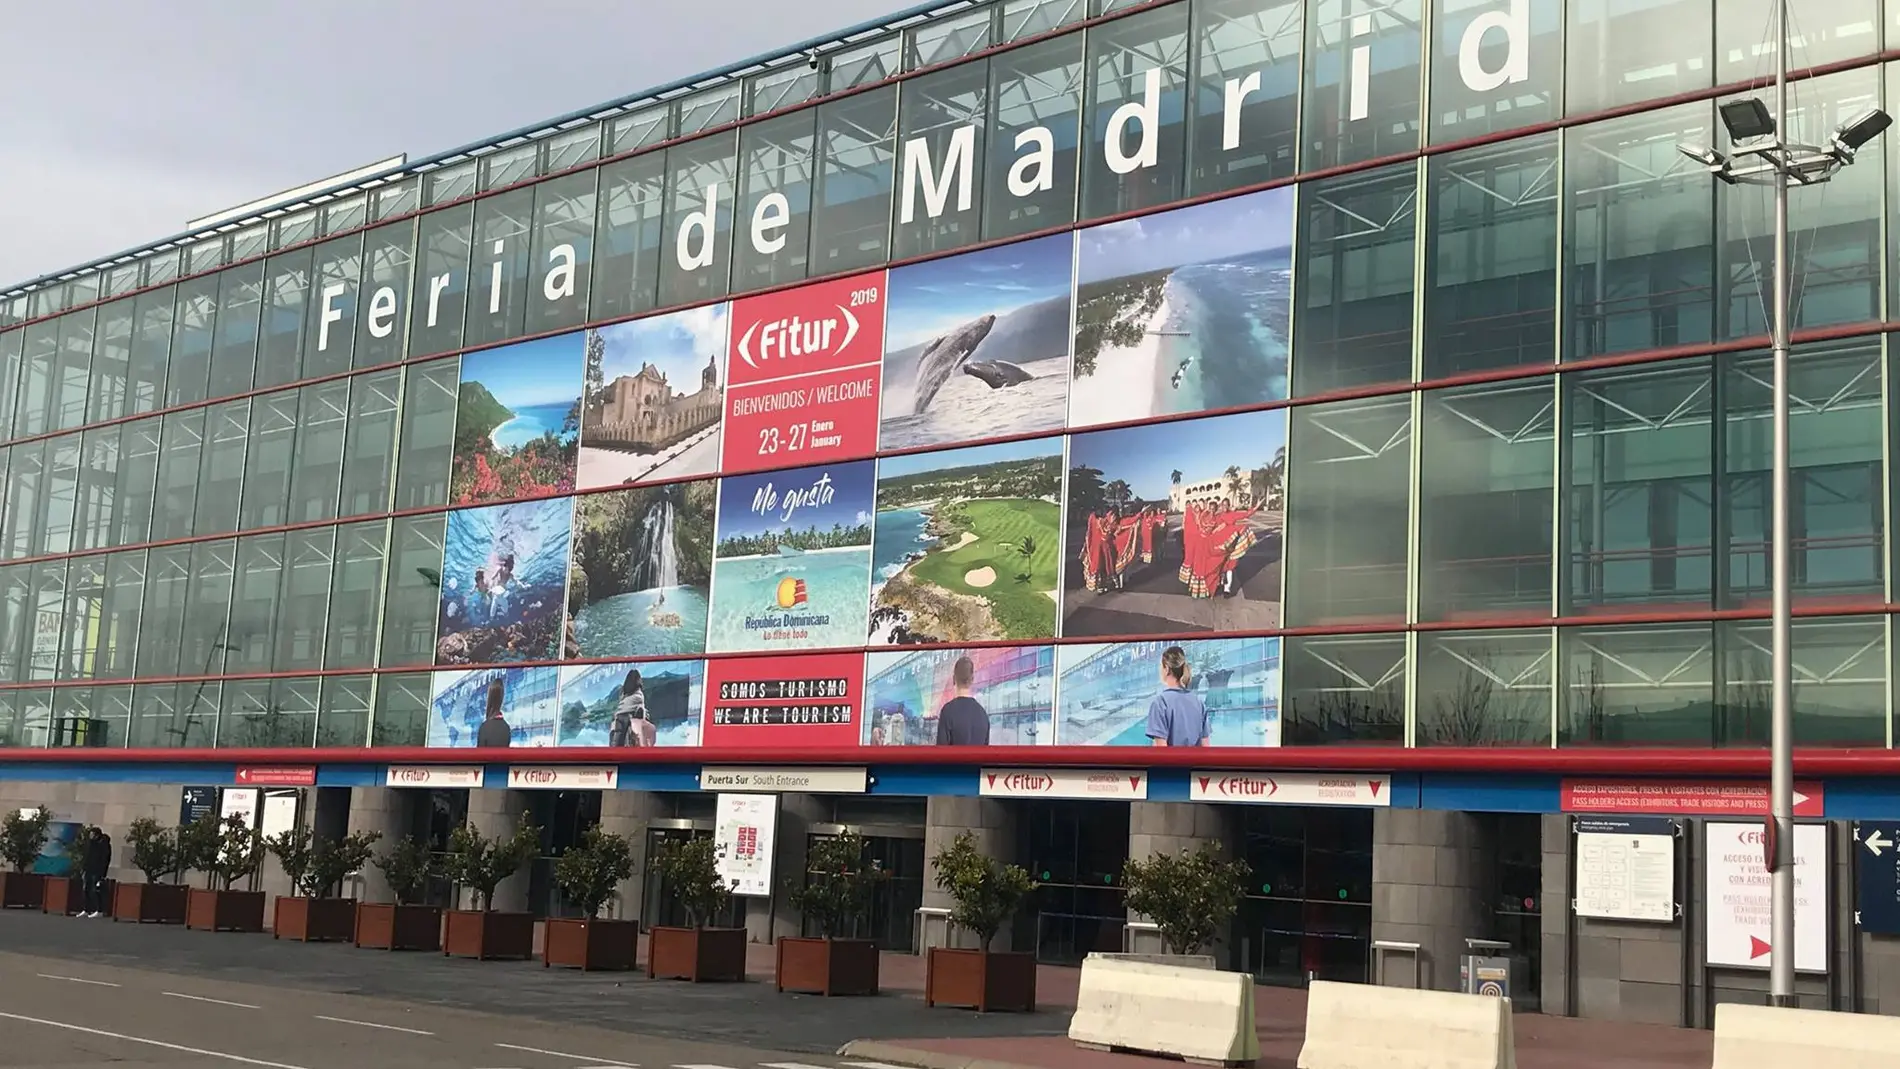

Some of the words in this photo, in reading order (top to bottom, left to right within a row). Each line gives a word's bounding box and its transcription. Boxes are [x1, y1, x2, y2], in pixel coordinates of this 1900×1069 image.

[317, 239, 576, 351] Feria
[676, 184, 790, 271] de
[900, 0, 1530, 224] Madrid
[850, 287, 877, 307] 2019
[760, 316, 838, 360] Fitur
[733, 389, 806, 416] BIENVENIDOS
[816, 379, 874, 404] WELCOME
[811, 420, 834, 432] Enero
[811, 434, 842, 448] January
[751, 482, 780, 516] Me
[780, 472, 835, 522] gusta
[783, 613, 830, 627] Dominicana
[792, 629, 809, 639] todo
[721, 682, 767, 699] SOMOS
[779, 680, 847, 698] TURISMO
[714, 707, 732, 724] WE
[743, 708, 769, 724] ARE
[782, 706, 851, 723] TOURISM
[530, 770, 552, 783] Fitur
[707, 774, 733, 785] Puerta
[735, 774, 748, 785] Sur
[753, 774, 775, 786] South
[776, 775, 810, 786] Entrance
[1013, 773, 1044, 790] Fitur
[1229, 777, 1267, 795] Fitur
[1572, 797, 1587, 806] PASS
[1588, 797, 1616, 806] HOLDERS
[1616, 798, 1640, 806] ACCESS
[1680, 799, 1700, 808] TRADE
[1701, 799, 1730, 808] VISITORS
[1730, 799, 1744, 808] AND
[1723, 855, 1752, 864] ACCESO
[1729, 875, 1744, 884] CON
